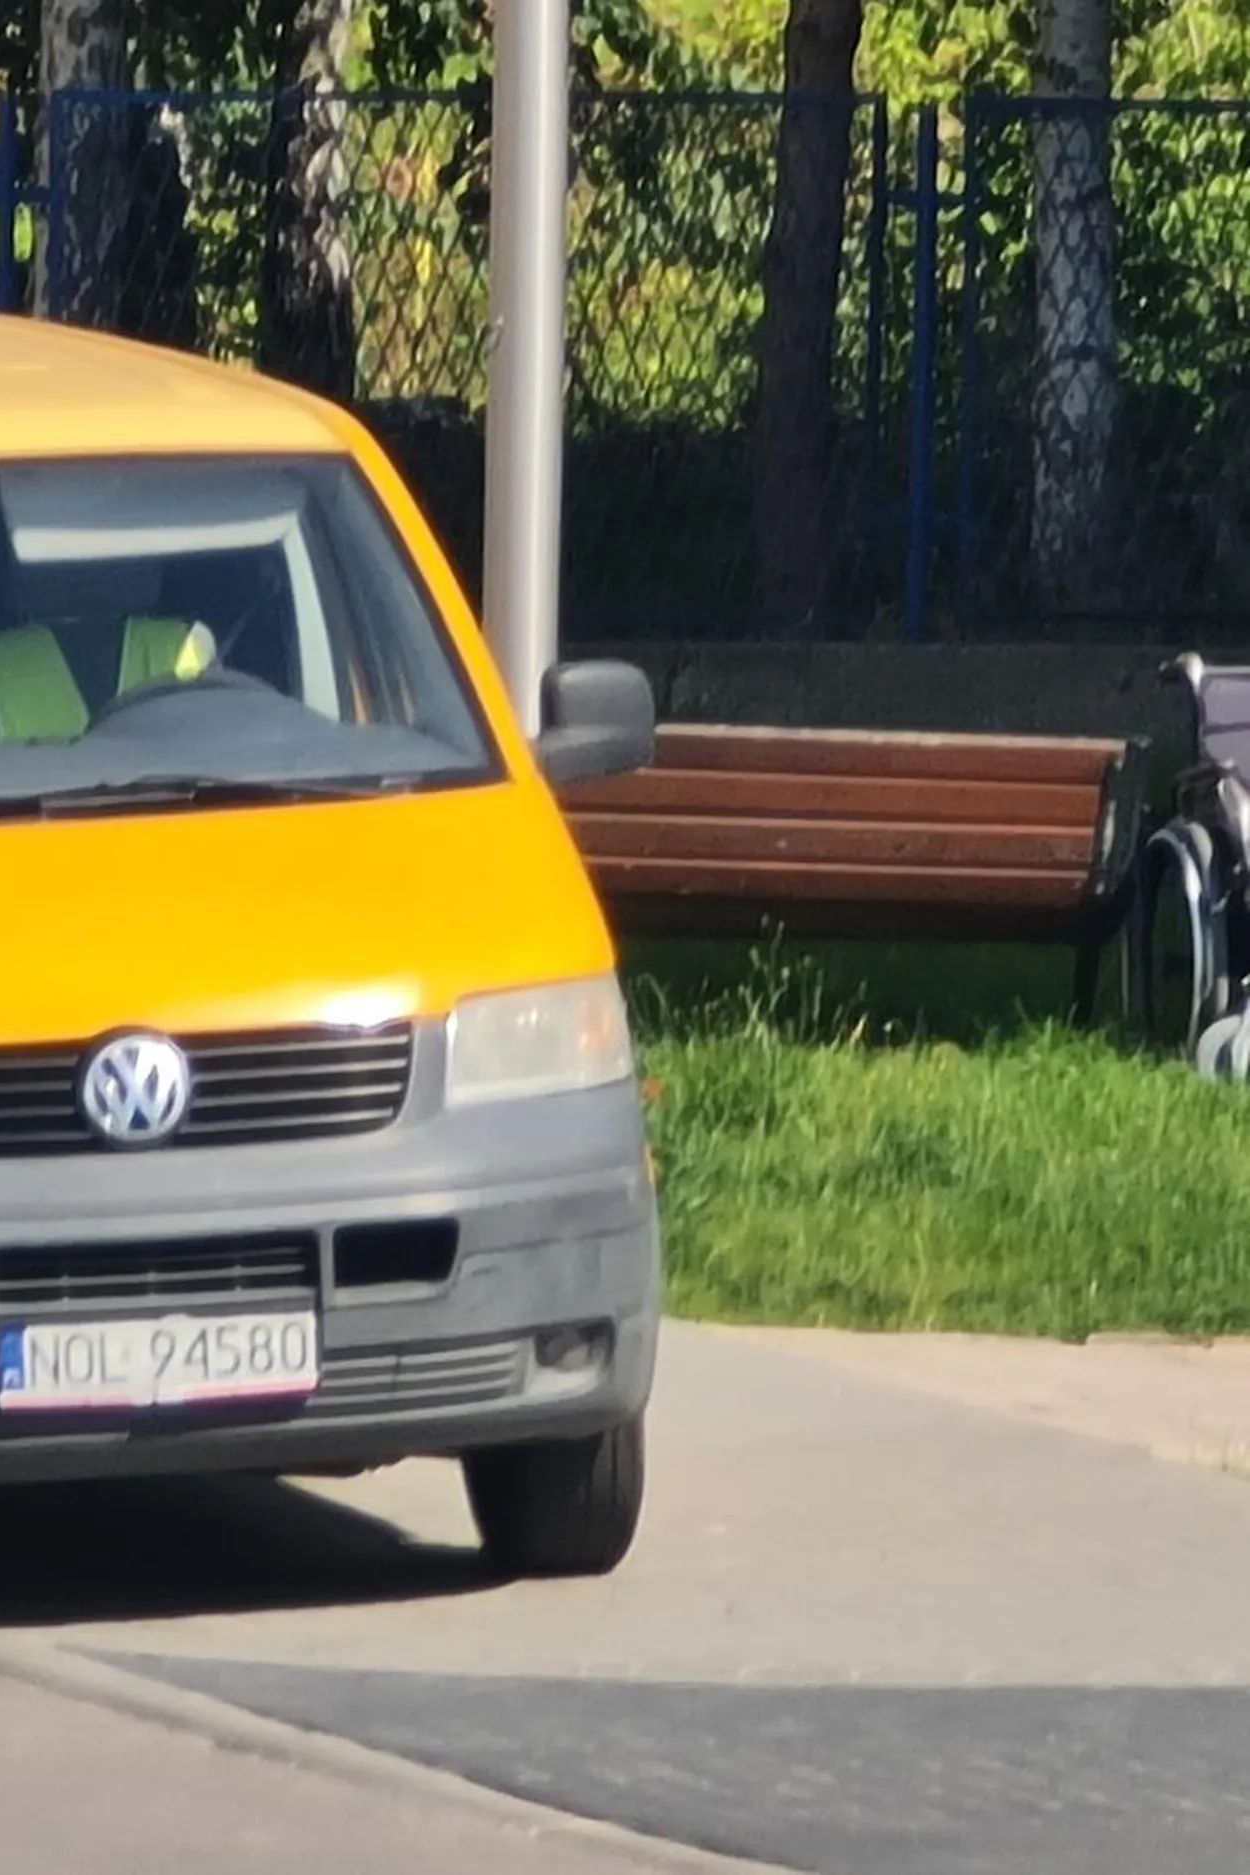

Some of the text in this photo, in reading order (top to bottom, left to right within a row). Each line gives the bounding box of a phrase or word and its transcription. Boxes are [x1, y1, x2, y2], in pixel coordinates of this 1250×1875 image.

[83, 1034, 188, 1141] VW
[29, 1322, 307, 1389] NOL 94580
